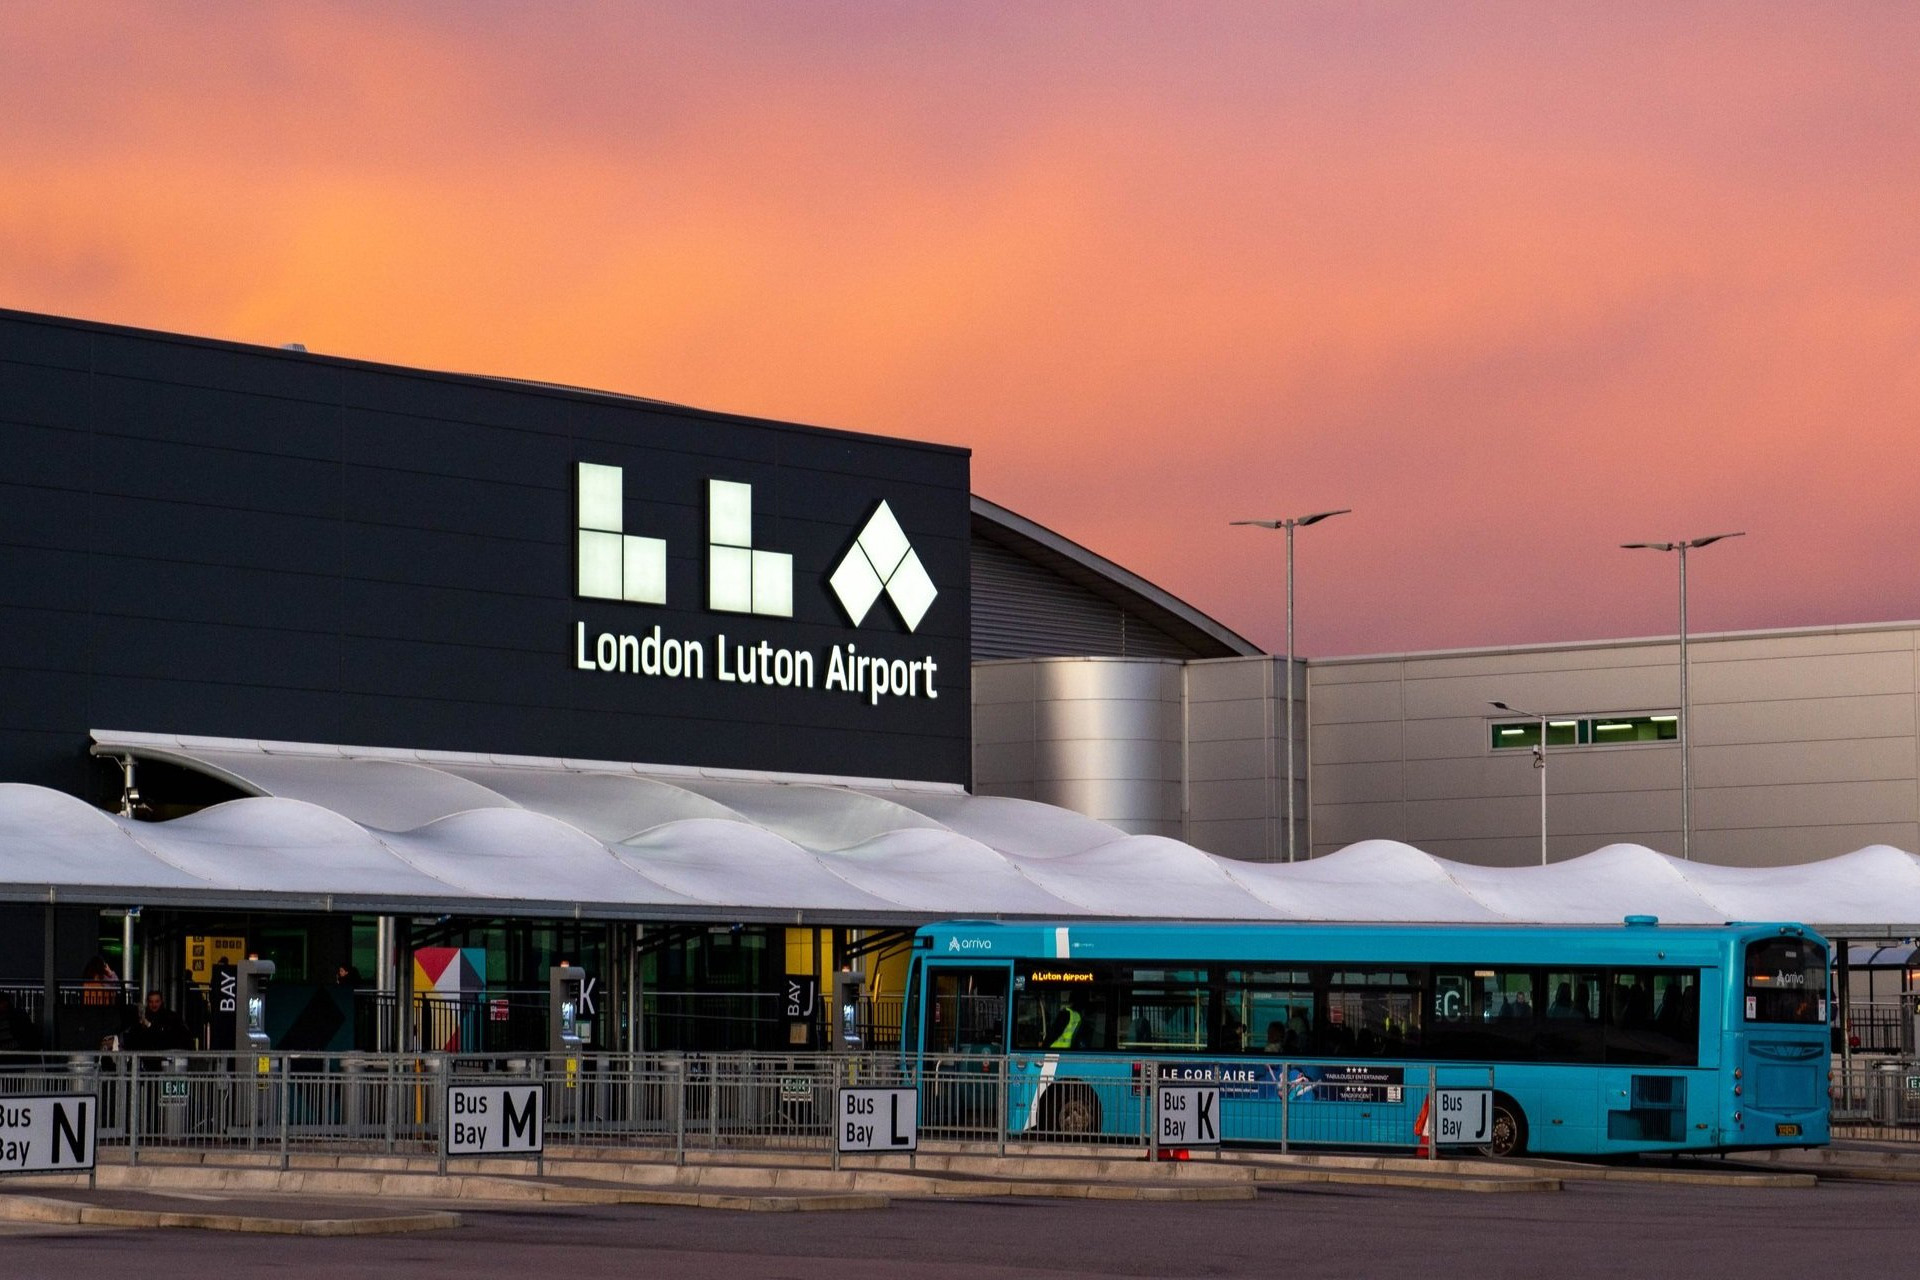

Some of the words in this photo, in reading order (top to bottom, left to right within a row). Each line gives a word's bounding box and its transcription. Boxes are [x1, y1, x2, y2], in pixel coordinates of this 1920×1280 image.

[577, 621, 704, 678] London
[718, 634, 814, 688] Luton
[825, 643, 938, 705] Airport
[961, 937, 992, 949] arriva
[1038, 972, 1062, 981] Luton
[1063, 972, 1094, 982] Airport
[219, 971, 236, 1012] BAY
[579, 977, 596, 1014] K
[787, 980, 801, 1016] BAY
[803, 981, 814, 1016] J
[1162, 1068, 1178, 1079] LE
[1184, 1069, 1255, 1081] CORAIRE
[454, 1092, 488, 1115] Bus
[846, 1094, 874, 1115] Bus
[1164, 1091, 1186, 1111] Bus
[1442, 1093, 1463, 1112] Bus
[502, 1090, 537, 1148] M
[890, 1093, 909, 1146] L
[1197, 1091, 1215, 1140] K
[1442, 1117, 1463, 1140] Bay
[1475, 1093, 1487, 1139] J
[51, 1102, 87, 1164] N
[454, 1122, 487, 1149] Bay
[846, 1122, 874, 1147] Bay
[1164, 1117, 1186, 1142] Bay
